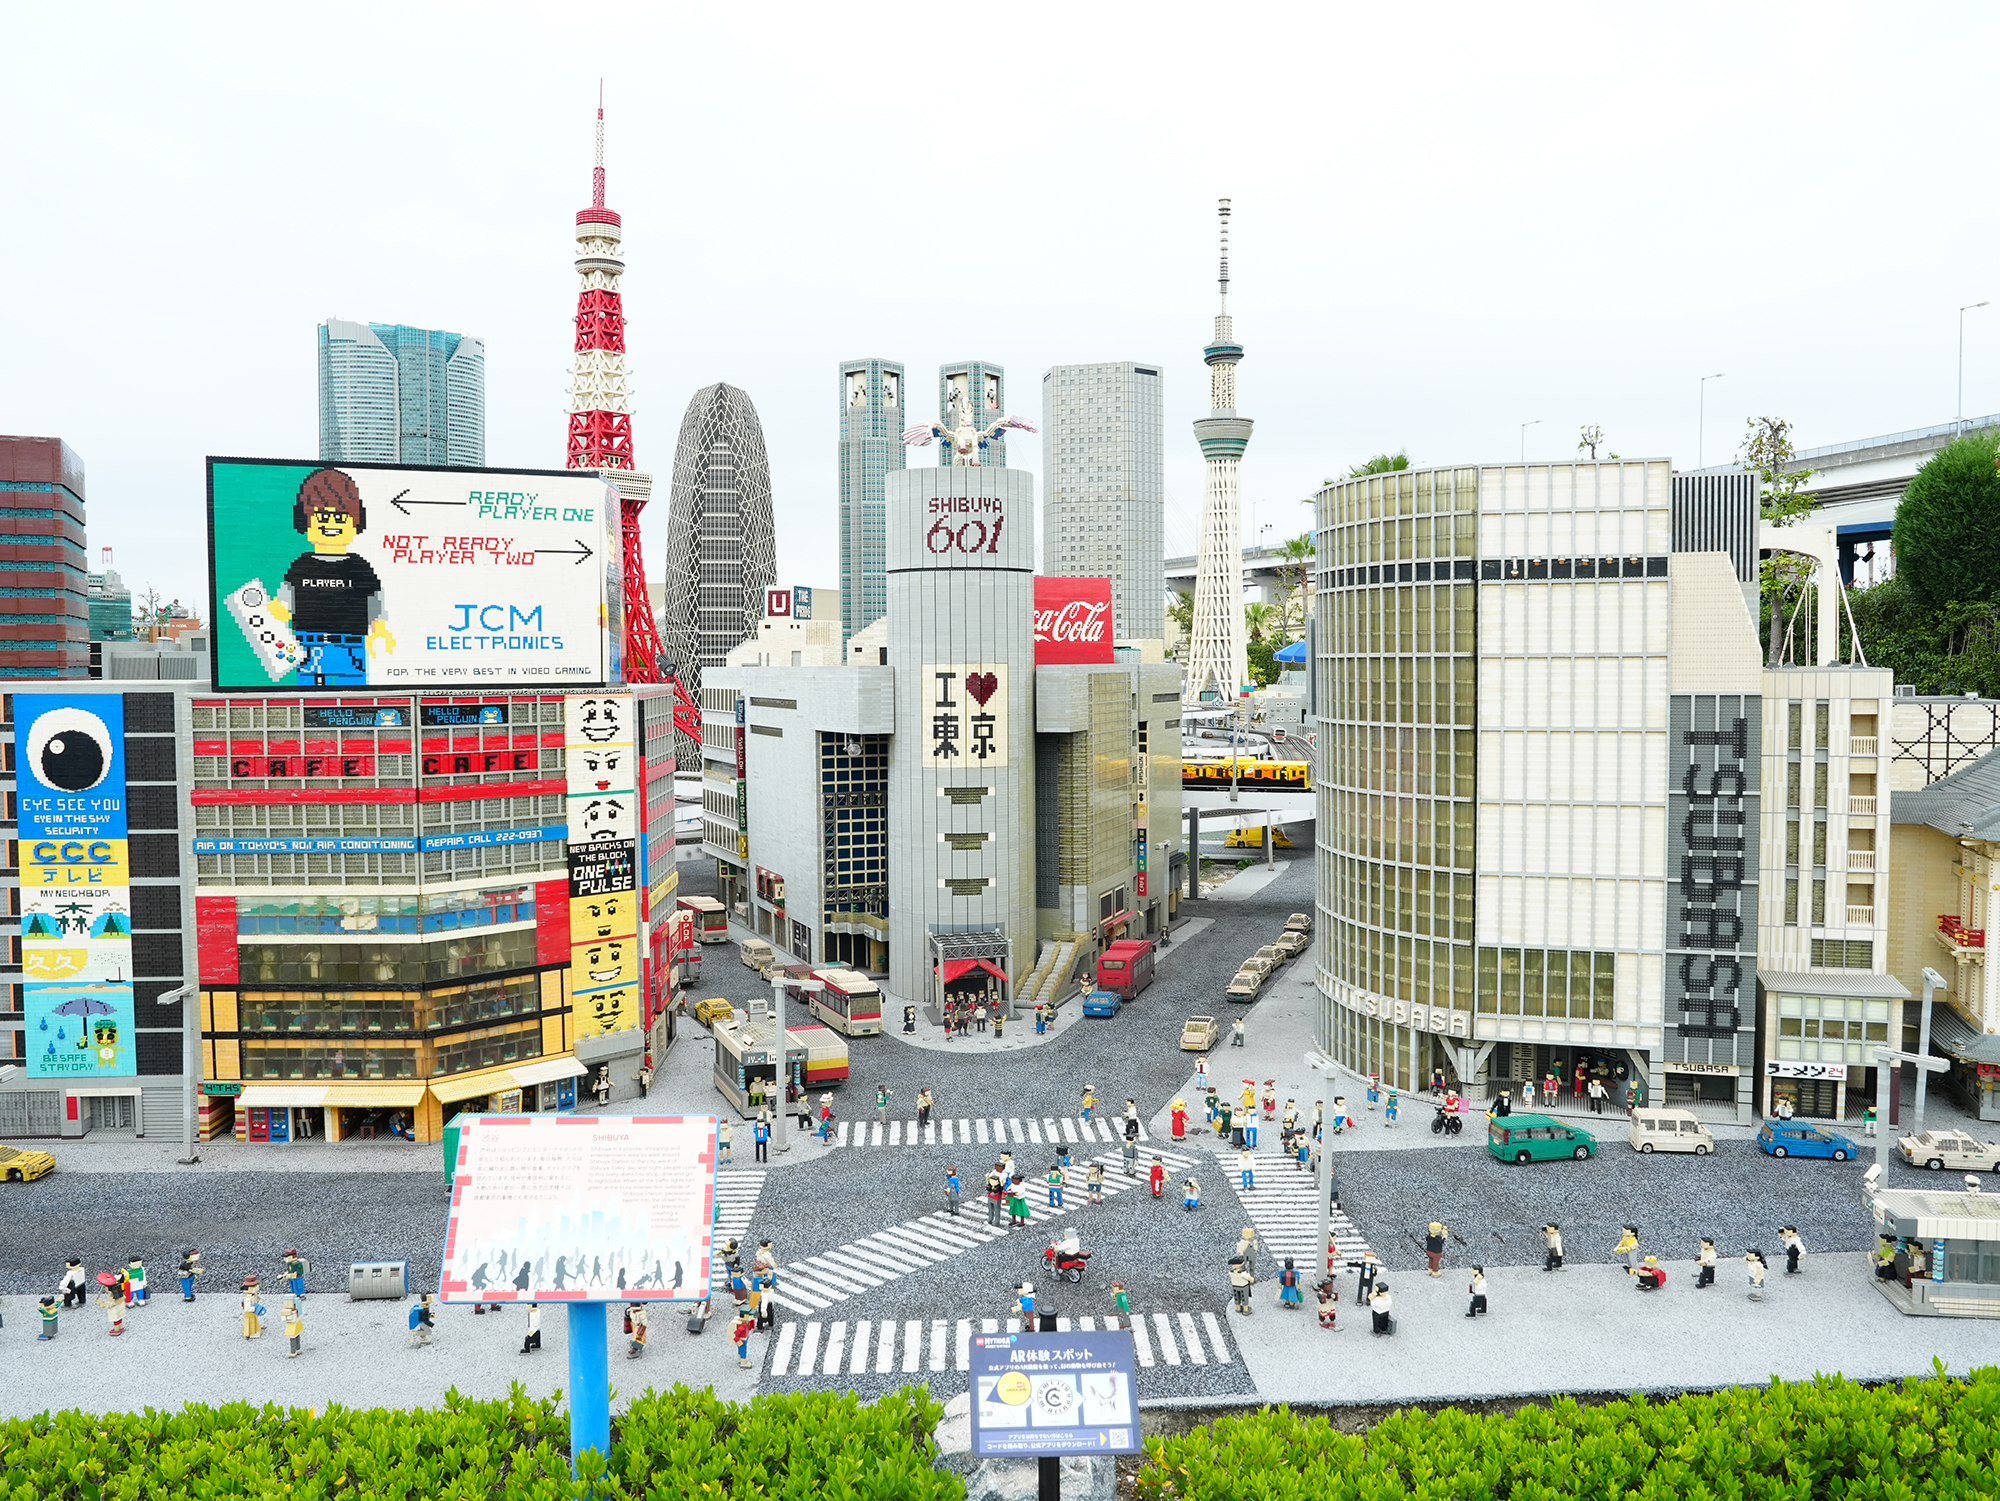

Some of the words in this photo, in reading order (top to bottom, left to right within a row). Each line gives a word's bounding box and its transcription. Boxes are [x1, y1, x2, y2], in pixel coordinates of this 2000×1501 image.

[469, 491, 539, 506] READY
[929, 497, 1002, 513] SHIBUYA
[479, 505, 557, 521] PLAYER
[563, 507, 595, 522] ONE
[927, 515, 1004, 553] 601
[383, 535, 429, 550] NOT
[443, 536, 514, 552] READY
[393, 549, 475, 564] PLAYER
[490, 551, 536, 566] TWO
[302, 578, 346, 588] PLAYER
[448, 604, 543, 632] JCM
[427, 635, 564, 650] ELECTRONICS
[386, 667, 410, 677] FOR
[414, 667, 438, 677] THE
[442, 667, 468, 677] VERY
[473, 667, 503, 677] BEST
[507, 667, 518, 677] IN
[522, 667, 550, 677] VIDEO
[554, 667, 592, 677] GAMING
[935, 672, 956, 707] I
[320, 709, 353, 717] HELLO
[428, 707, 460, 716] HELLO
[328, 717, 373, 725] PENGUIN
[437, 715, 478, 724] PENGUIN
[933, 712, 996, 759] 東京
[233, 759, 360, 777] CAFE
[424, 753, 528, 775] CAFE
[22, 798, 52, 811] EYE
[57, 798, 85, 811] SEE
[91, 798, 120, 811] YOU
[34, 814, 52, 823] EYE
[52, 814, 63, 823] IN
[66, 814, 89, 823] THE
[90, 814, 110, 823] SKY
[44, 827, 99, 835] SECURITY
[196, 841, 216, 850] AIR
[219, 841, 234, 850] ON
[239, 841, 287, 850] TOKYO'S
[317, 841, 336, 850] AIR
[341, 841, 415, 850] CONDITIONING
[426, 838, 464, 848] REPAIR
[468, 834, 492, 843] CALL
[569, 845, 587, 854] NEW
[588, 842, 621, 852] BRICKS
[622, 839, 635, 849] ON
[33, 842, 111, 862] CCC
[578, 854, 596, 863] THE
[598, 851, 628, 861] BLOCK
[43, 868, 102, 883] テレビ
[572, 864, 605, 881] ONE
[1678, 718, 1747, 1039] TSUBASA
[579, 876, 633, 895] PULSE
[40, 889, 55, 898] MY
[55, 889, 110, 898] NEIGHBOR
[1354, 989, 1468, 1037] TSUBASA
[43, 1054, 58, 1062] BE
[61, 1054, 87, 1062] SAFE
[39, 1063, 70, 1072] STAY
[1673, 1063, 1729, 1074] TSUBASA
[1828, 1067, 1844, 1076] 24
[592, 1134, 630, 1142] SHIBUYA
